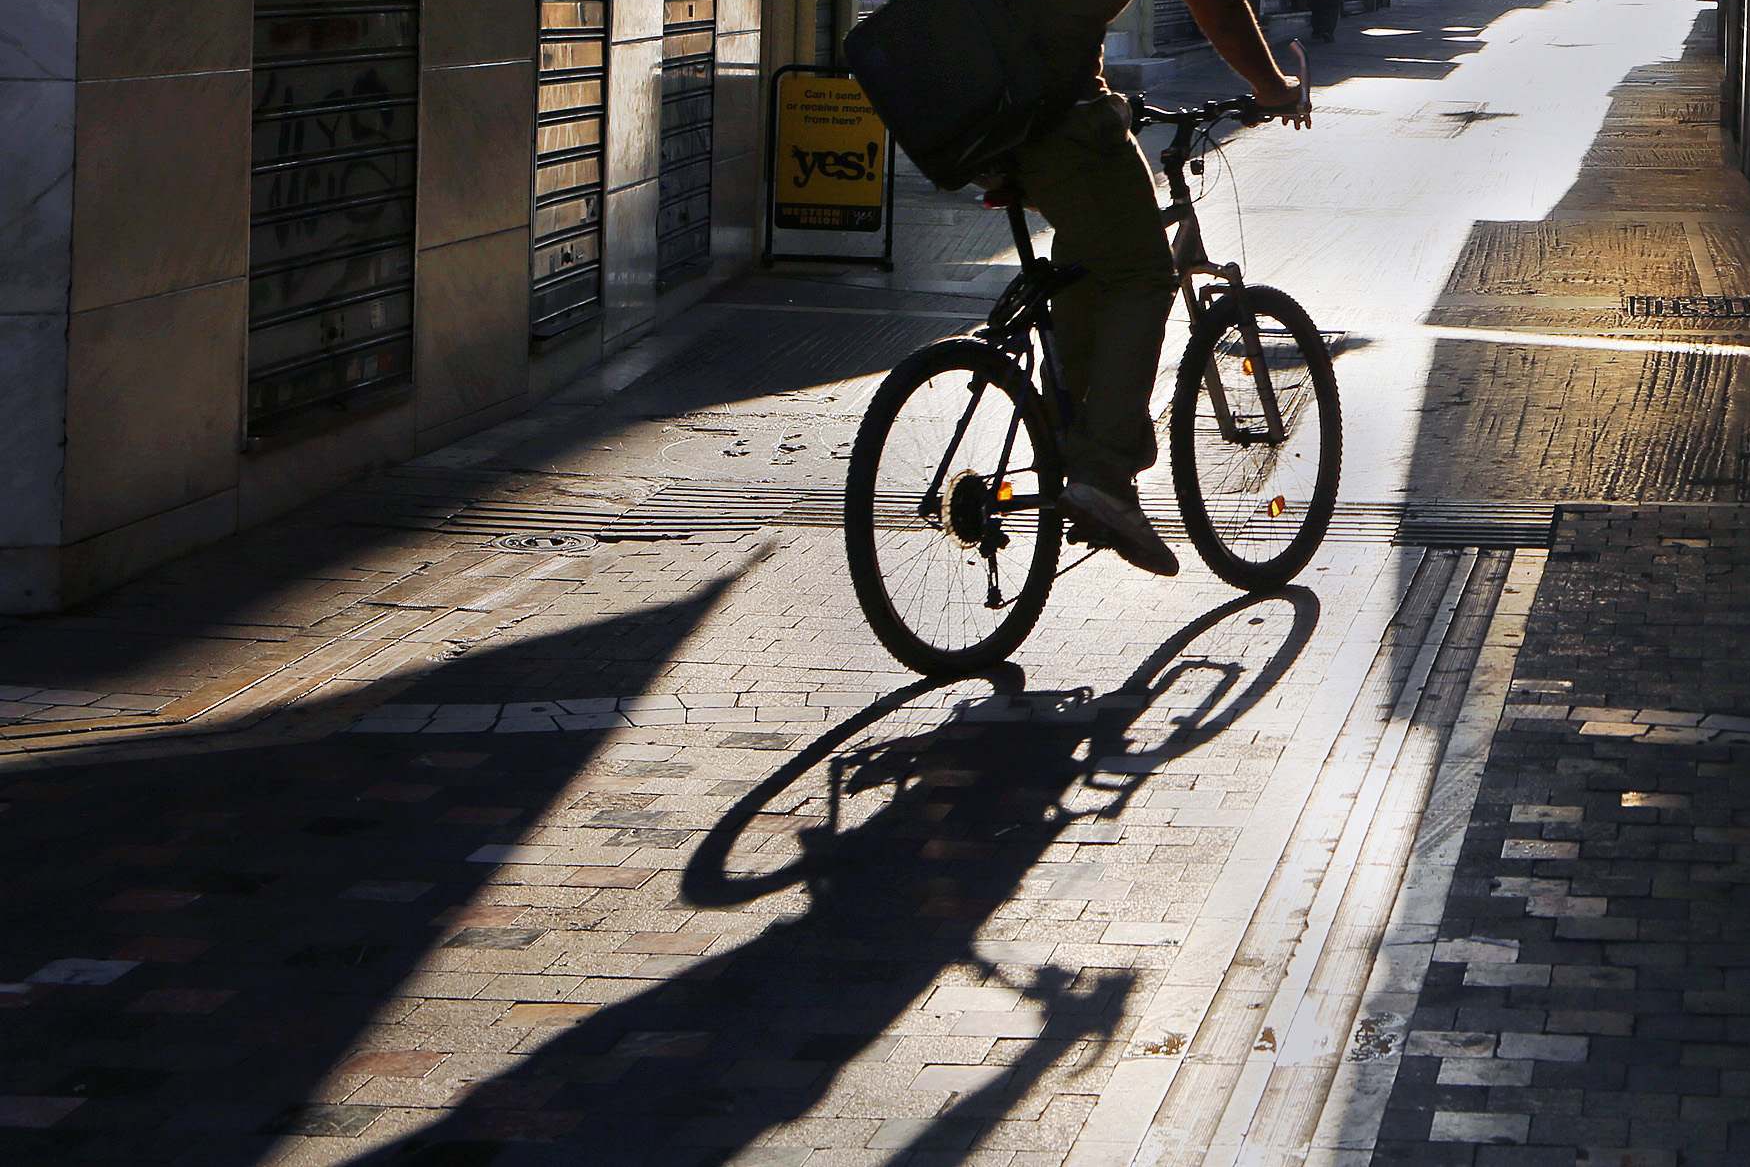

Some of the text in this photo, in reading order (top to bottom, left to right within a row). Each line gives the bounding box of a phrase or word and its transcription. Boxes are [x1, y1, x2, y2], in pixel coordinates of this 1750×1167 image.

[804, 89, 826, 99] Can
[834, 90, 861, 101] send
[786, 102, 876, 116] or receive money
[804, 115, 863, 126] from here?
[792, 141, 878, 188] yes!
[783, 207, 841, 218] WESTERN
[800, 216, 841, 227] UNION
